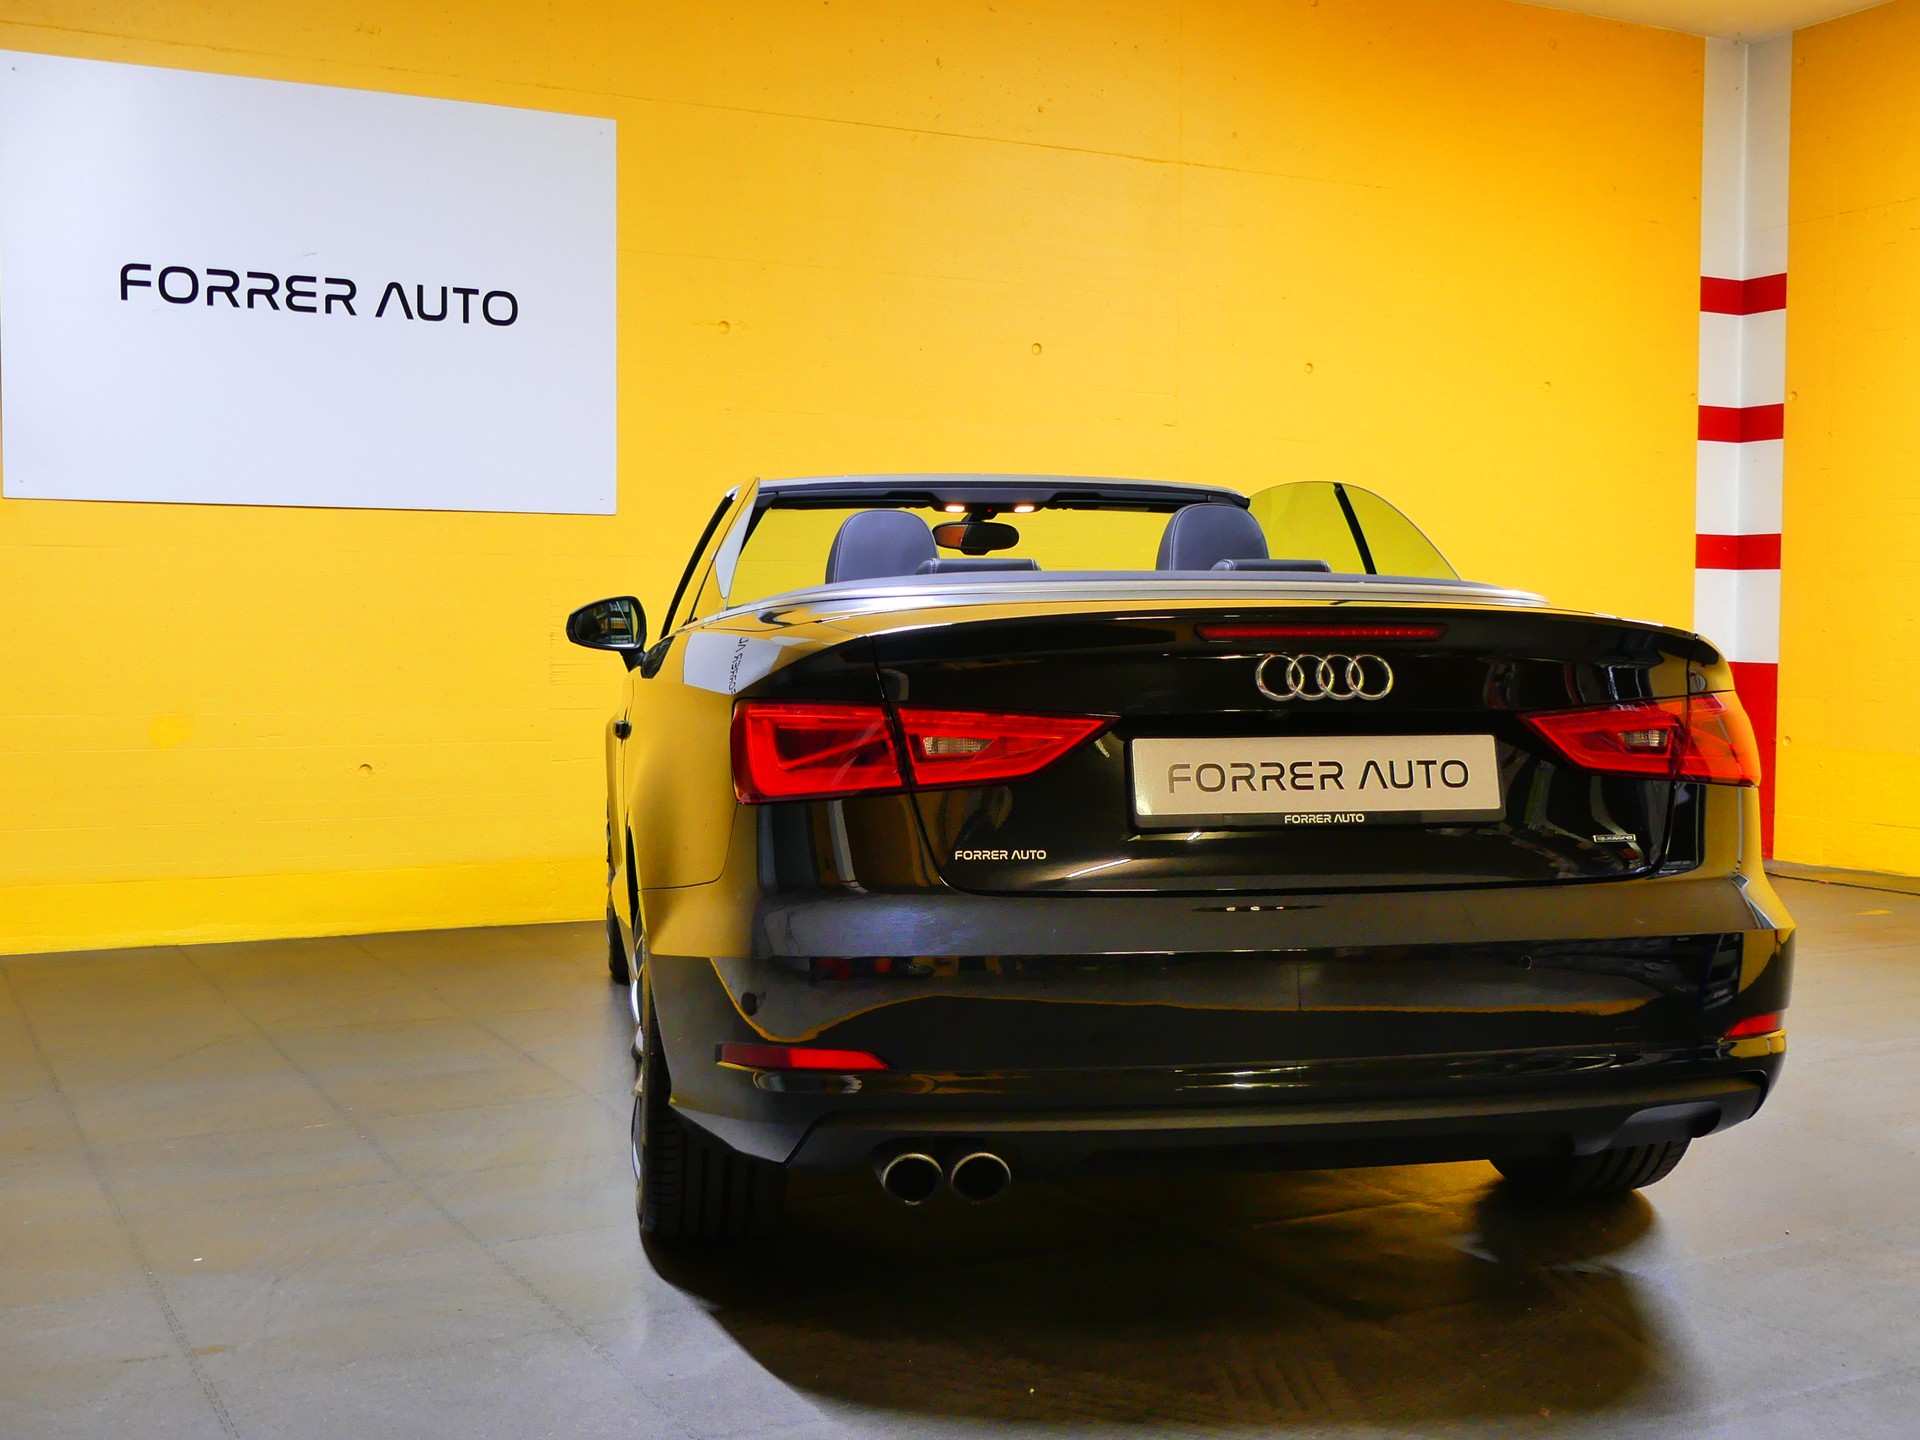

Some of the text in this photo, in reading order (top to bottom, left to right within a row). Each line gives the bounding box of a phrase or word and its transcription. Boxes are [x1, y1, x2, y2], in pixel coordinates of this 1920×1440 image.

[120, 263, 518, 326] FORRER AUTO
[1168, 760, 1469, 793] FORRER AUTO
[1284, 813, 1365, 824] FORRER AUTO
[954, 849, 1046, 860] FORRER AUTO
